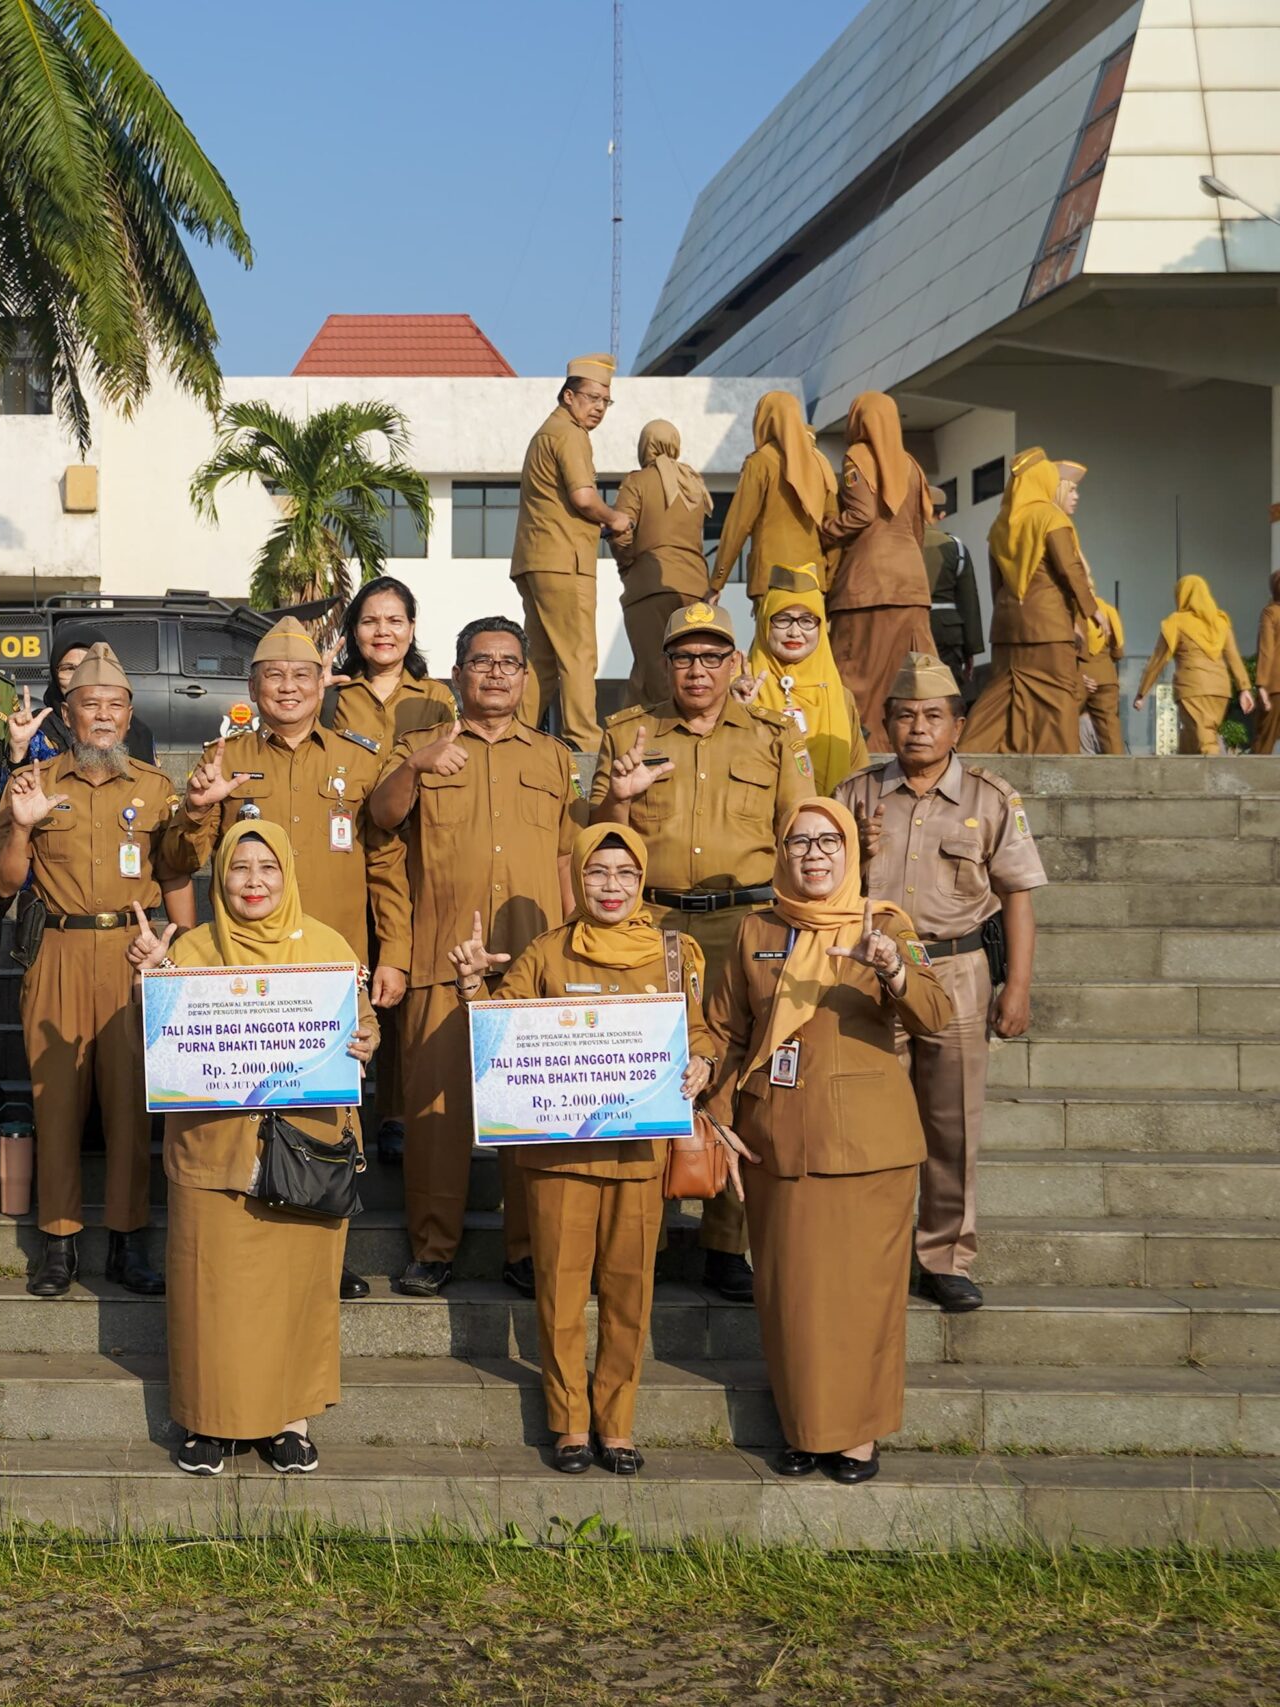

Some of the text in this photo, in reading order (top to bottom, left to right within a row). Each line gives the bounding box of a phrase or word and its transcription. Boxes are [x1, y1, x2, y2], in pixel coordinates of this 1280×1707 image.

[162, 1020, 340, 1036] TALI ASIH BAGI ANGGOTA KORPRI
[178, 1039, 326, 1053] PURNA BHAKTI TAHUN 2026
[491, 1052, 670, 1069] TALI ASIH BAGI ANGGOTA KORPRI
[202, 1062, 303, 1078] Rp. 2.000.000,-
[507, 1070, 656, 1085] PURNA BHAKTI TAHUN 2026
[206, 1080, 300, 1091] (DUA JUTA RUPIAH)
[532, 1093, 634, 1110] Rp. 2.000.000,-
[536, 1112, 631, 1123] (DUA JUTA RUPIAH)
